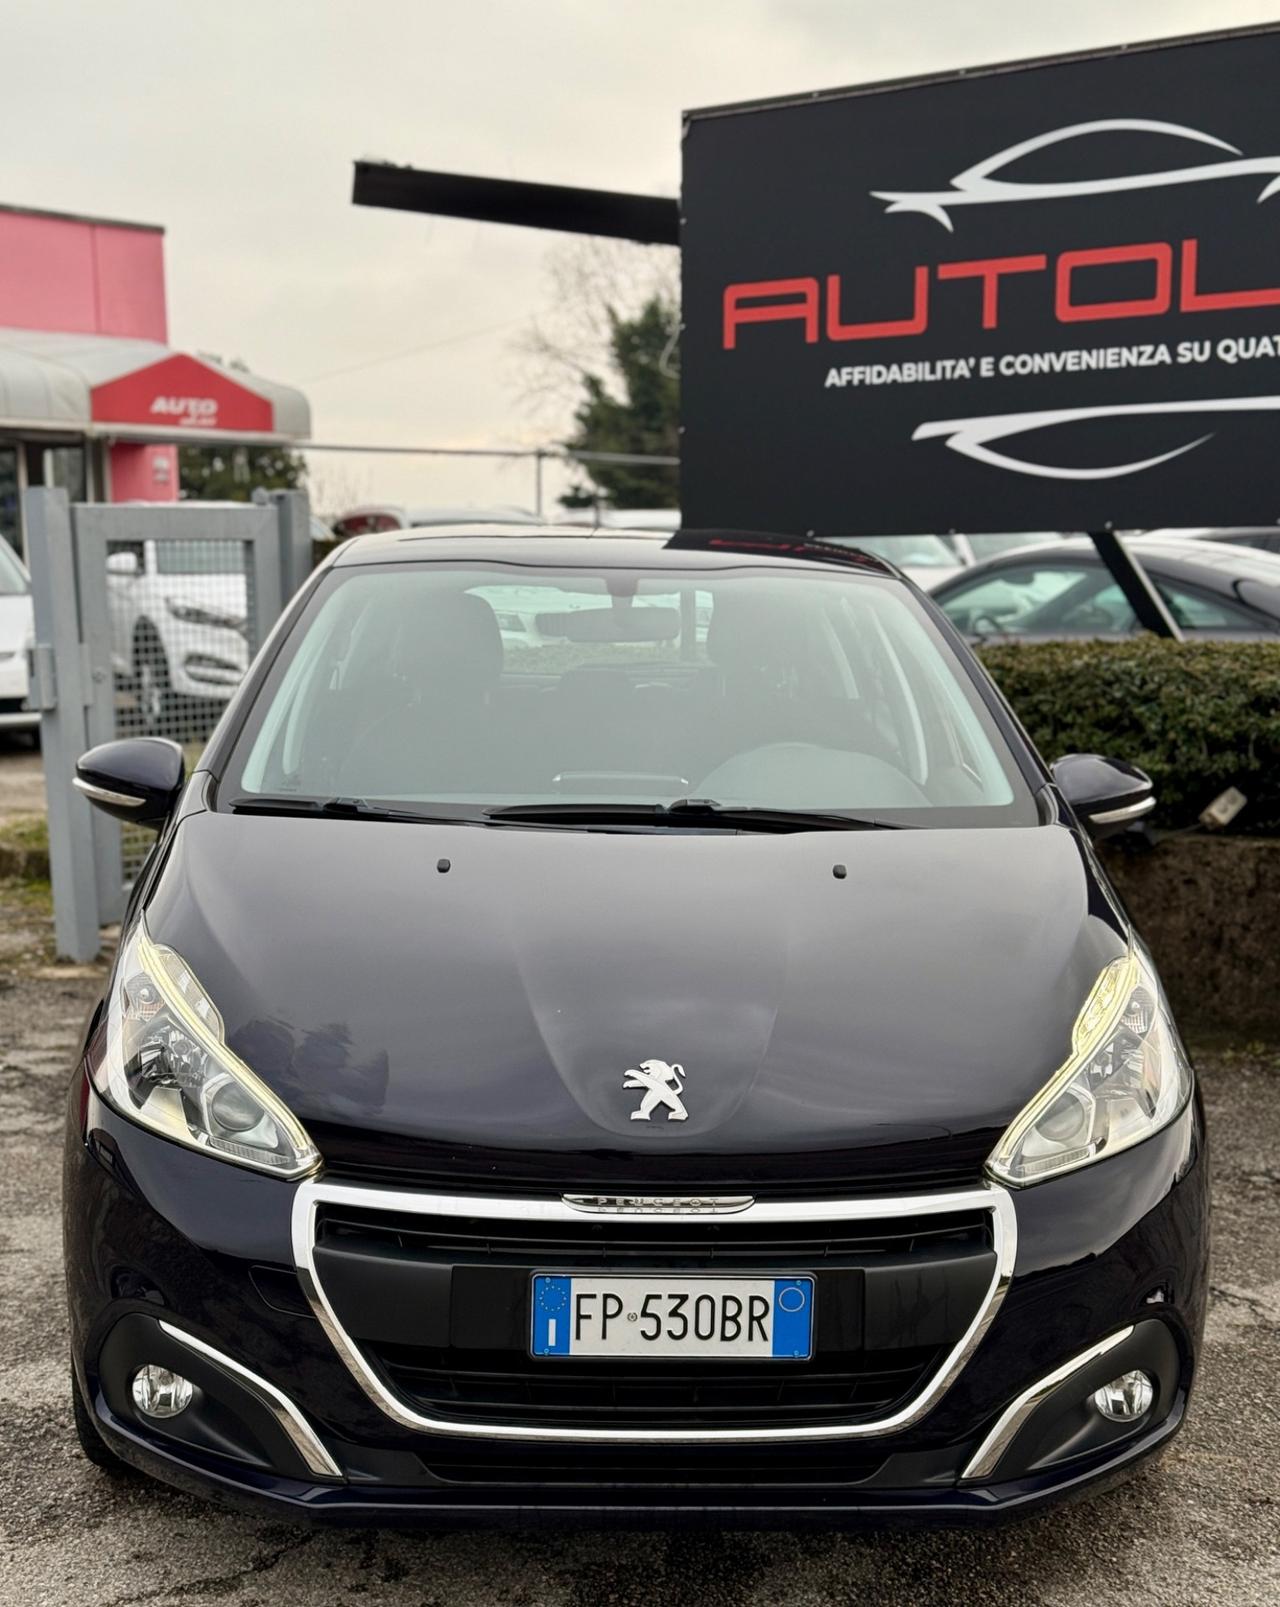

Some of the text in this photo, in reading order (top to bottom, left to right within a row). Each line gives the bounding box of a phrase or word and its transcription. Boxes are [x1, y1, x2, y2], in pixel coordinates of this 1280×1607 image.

[824, 357, 976, 388] AFFIDABILITA'
[979, 355, 995, 378] E
[998, 343, 1173, 376] CONVENIENZA
[1176, 340, 1212, 365] SU
